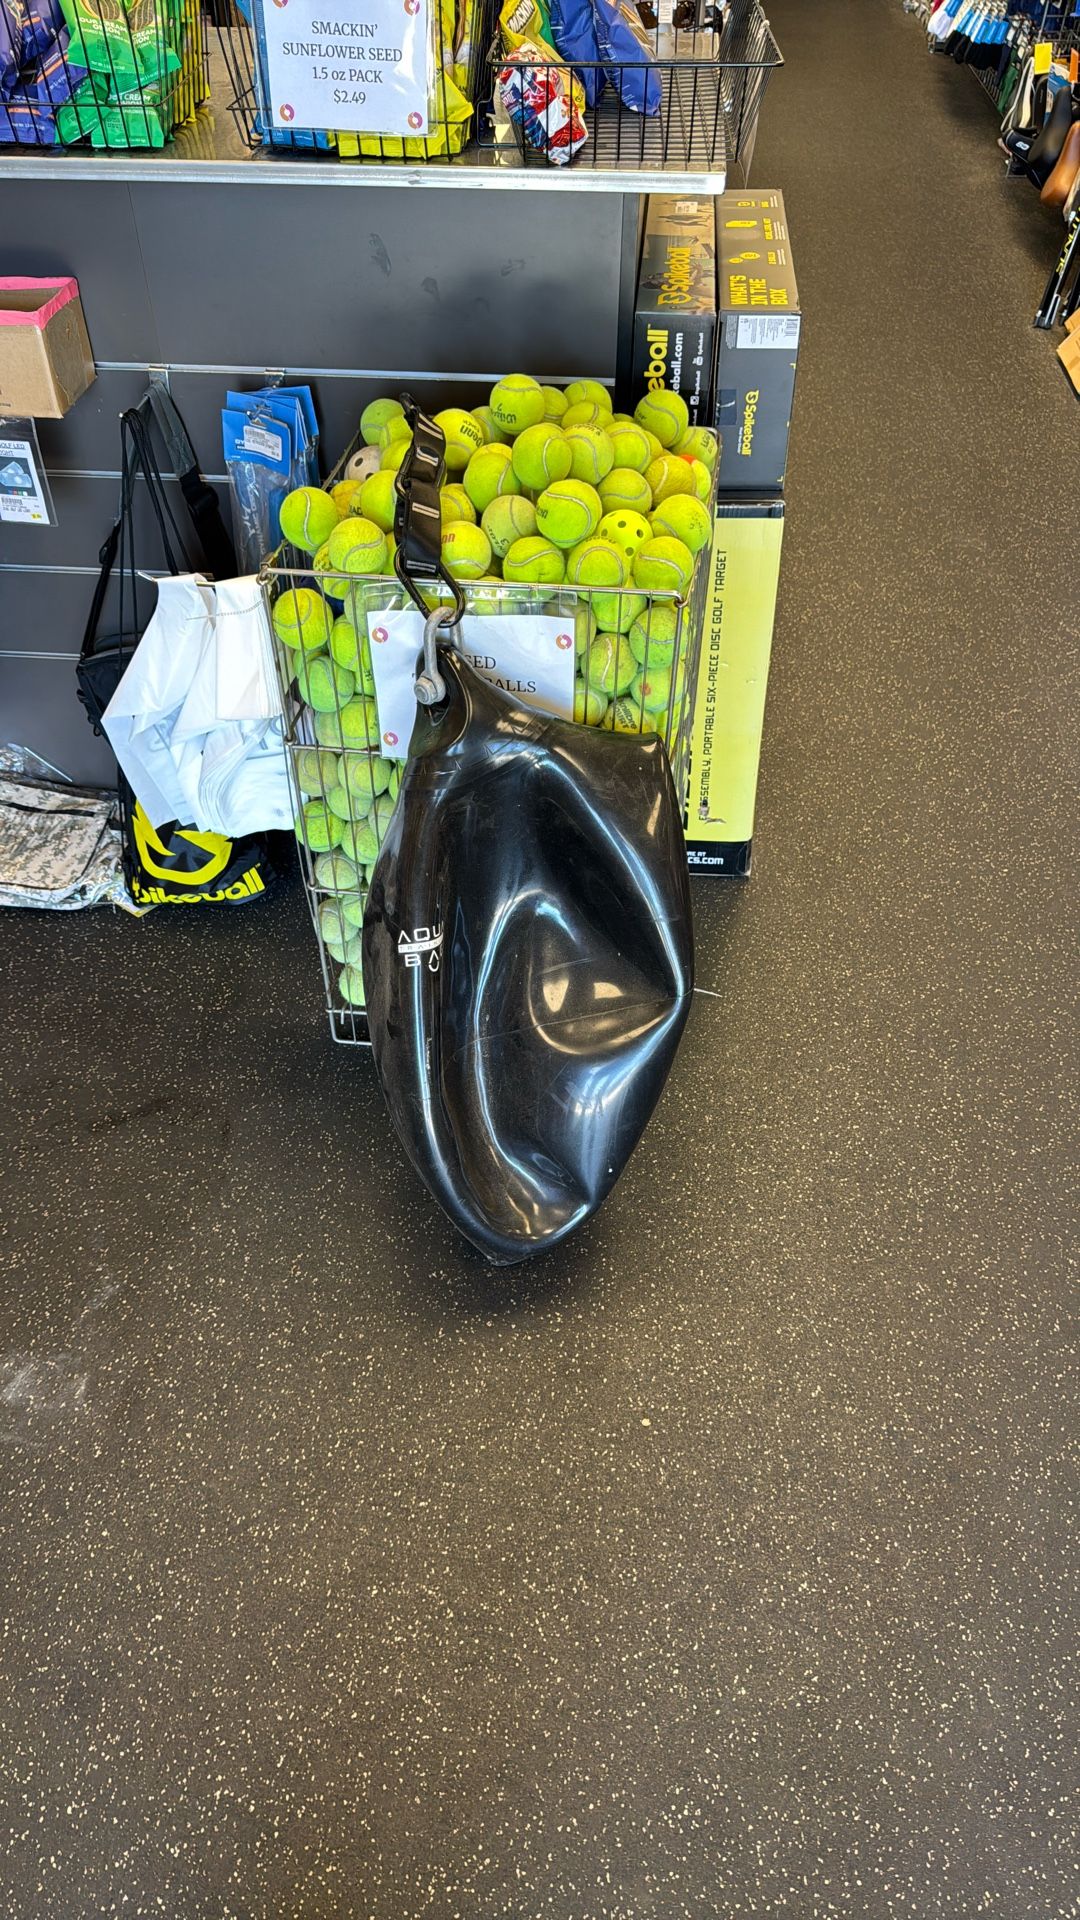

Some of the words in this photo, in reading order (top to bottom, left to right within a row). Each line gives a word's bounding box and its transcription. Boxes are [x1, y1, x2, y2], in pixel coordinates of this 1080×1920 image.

[311, 20, 378, 38] SMACKIN’
[282, 42, 365, 60] SUNFLOWER
[368, 47, 403, 62] SEED
[312, 66, 328, 80] 1.5
[331, 70, 346, 81] oz
[349, 68, 383, 84] PACK
[333, 88, 366, 104] $2.49
[660, 246, 695, 293] Spikeball
[748, 278, 768, 294] THE
[769, 287, 789, 305] BOX
[750, 294, 769, 306] IN
[643, 328, 669, 393] eball
[741, 404, 758, 456] Spikeball
[441, 533, 456, 544] nn
[715, 549, 728, 593] TARGET
[712, 596, 724, 625] GOLF
[711, 627, 722, 651] DISC
[706, 653, 720, 704] SIX-PIECE
[702, 706, 716, 757] PORTABLE
[397, 924, 444, 944] AQU
[405, 949, 443, 972] BA
